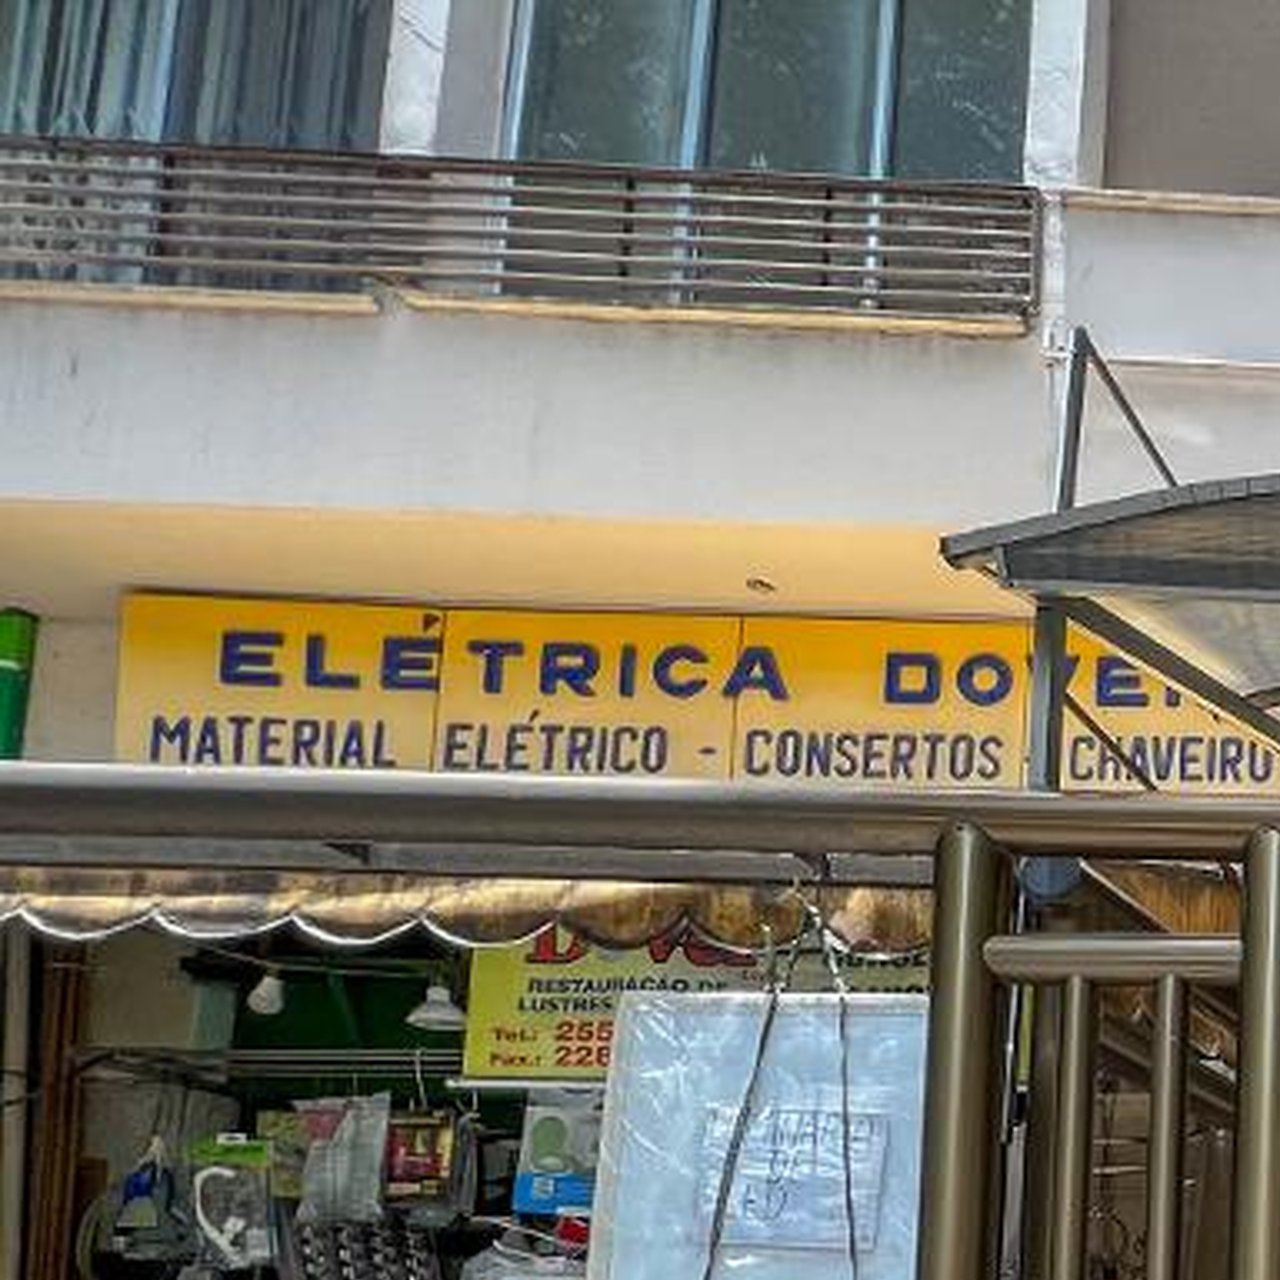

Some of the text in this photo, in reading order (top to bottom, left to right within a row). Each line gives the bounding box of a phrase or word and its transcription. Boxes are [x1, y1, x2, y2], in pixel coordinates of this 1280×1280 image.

[219, 612, 790, 700] ELÉTRICA
[149, 715, 398, 769] MATERIAL
[442, 710, 669, 775] ELÉTRICO
[744, 727, 1005, 781] CONSERTOS
